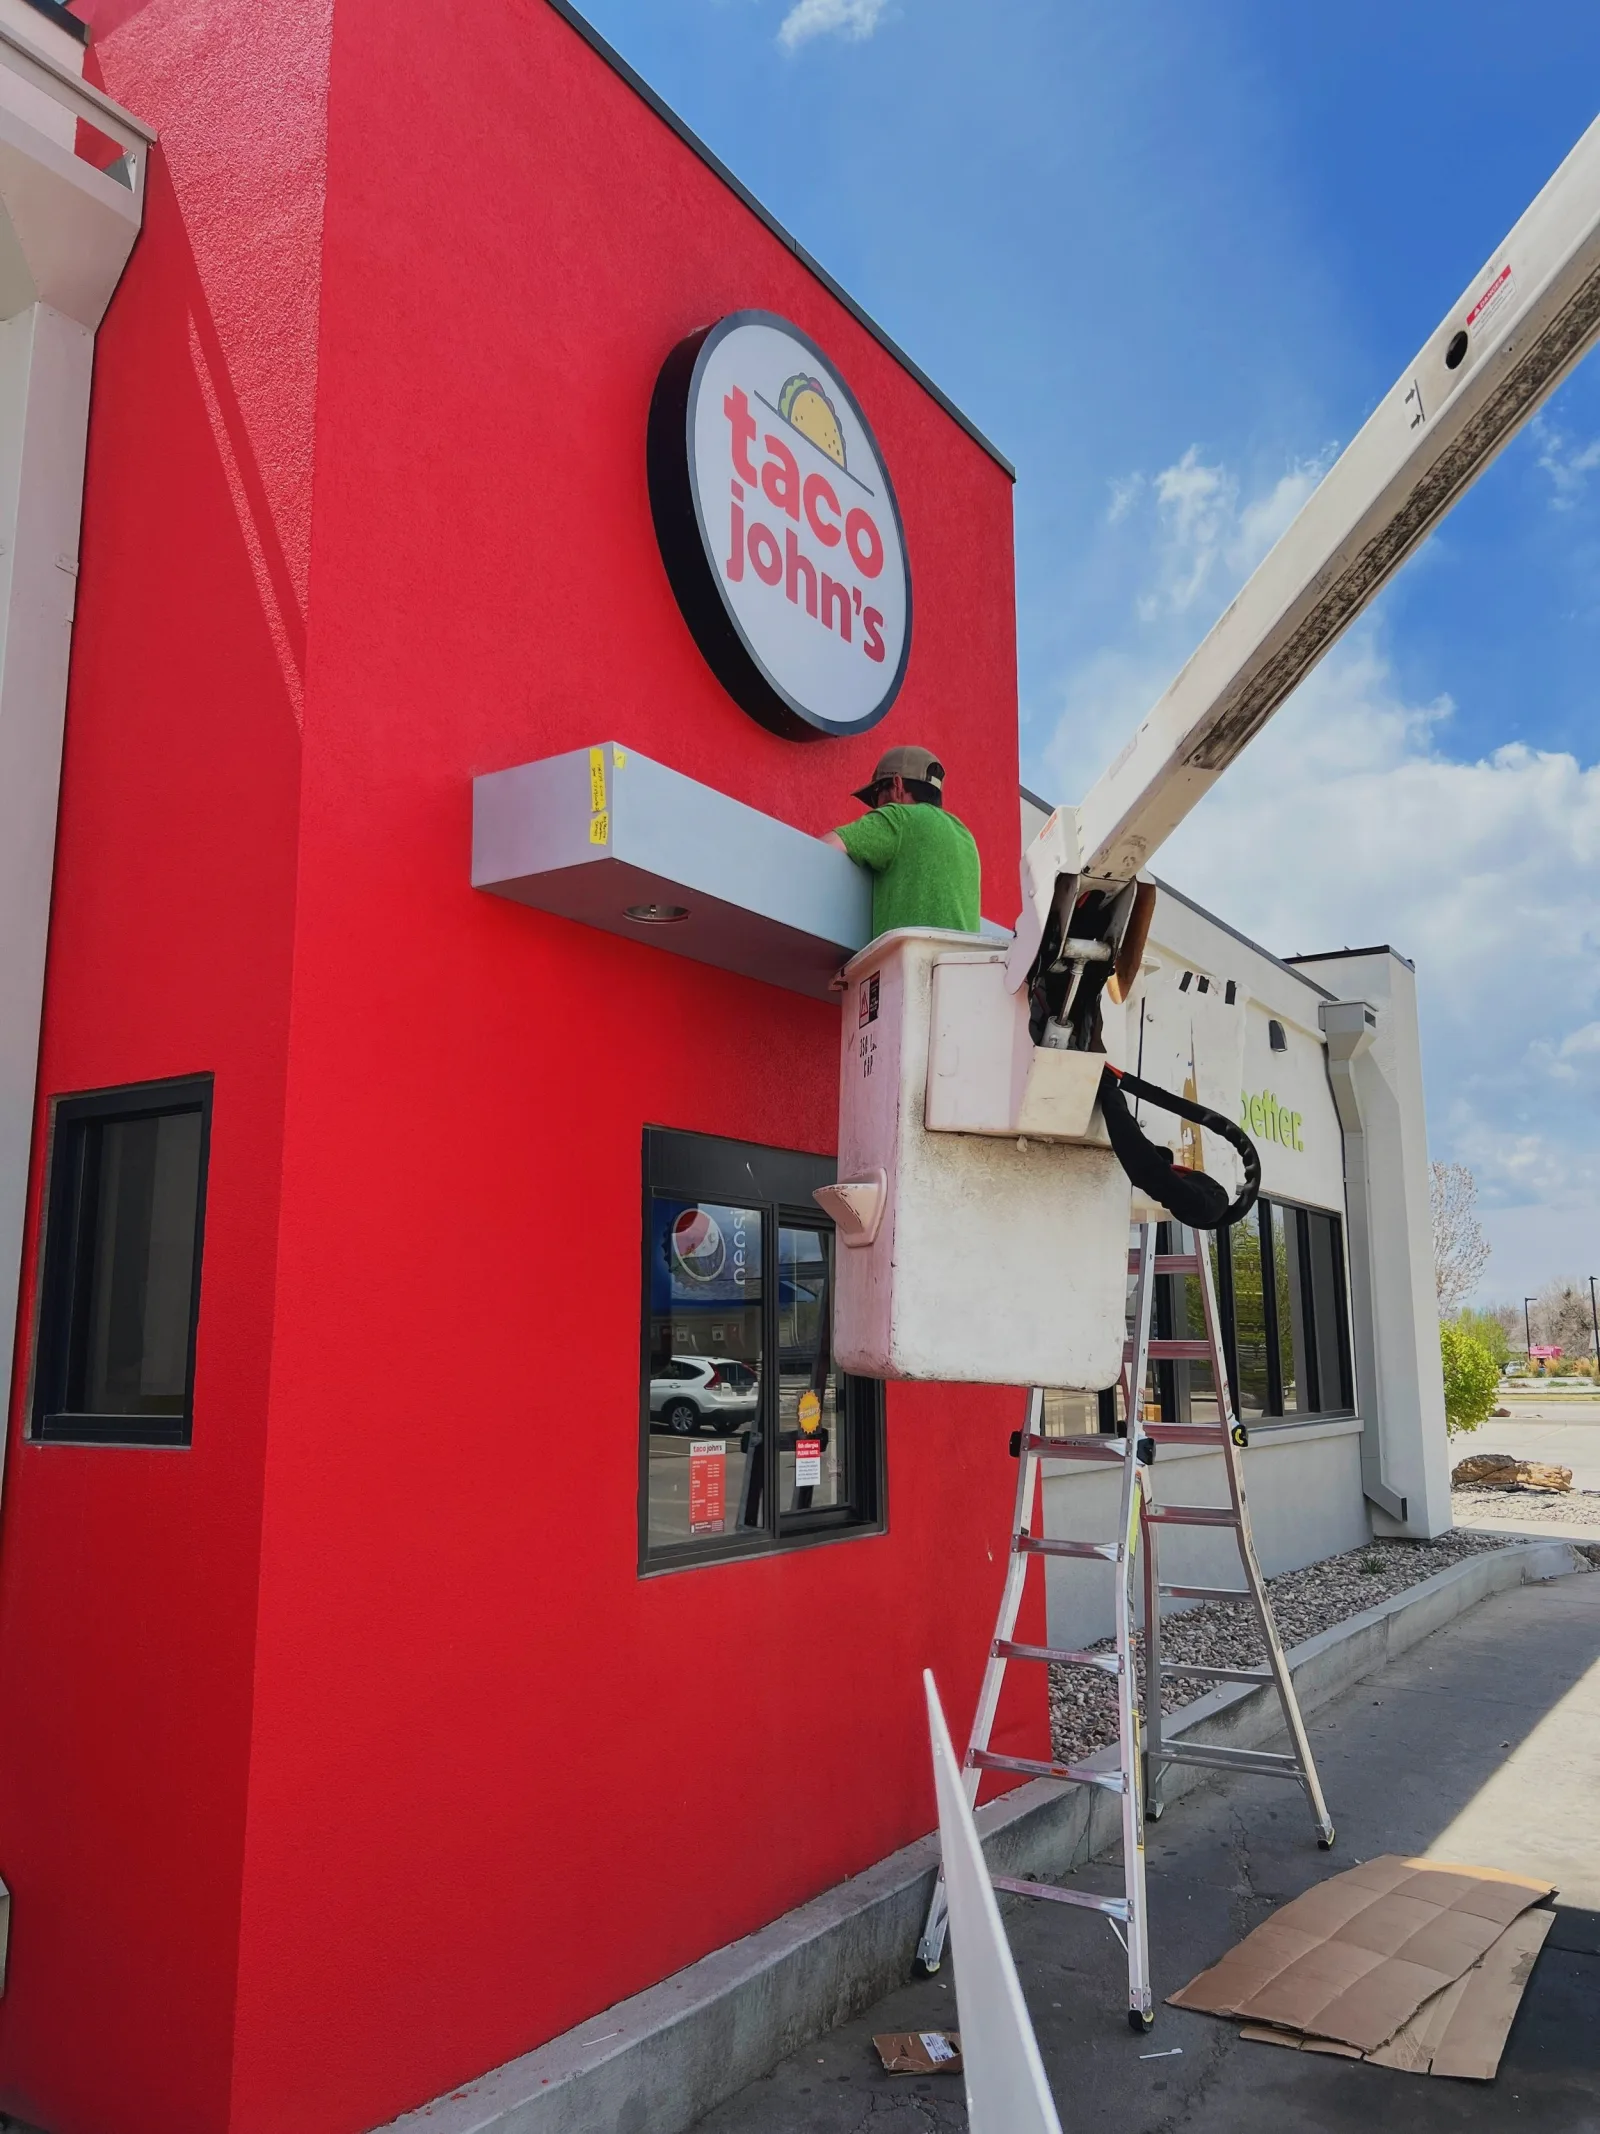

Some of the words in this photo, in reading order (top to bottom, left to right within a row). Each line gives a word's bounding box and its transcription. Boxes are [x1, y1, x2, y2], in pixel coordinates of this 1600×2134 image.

[1480, 276, 1504, 308] DANGER
[724, 385, 884, 578] taco
[726, 479, 886, 663] john's
[693, 1445, 706, 1453] taco
[706, 1444, 722, 1453] john's
